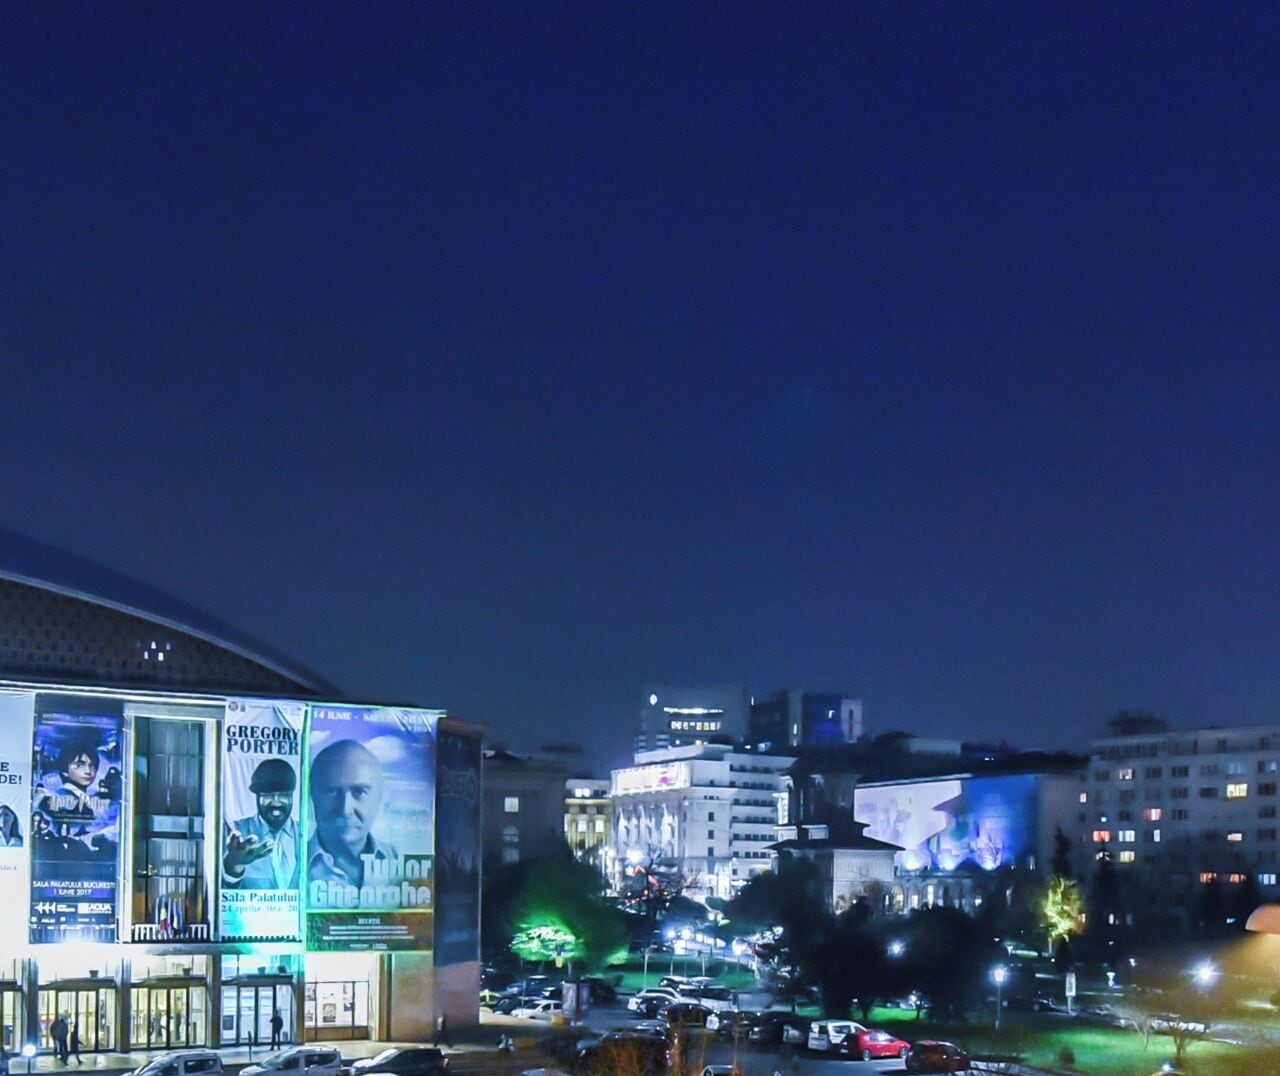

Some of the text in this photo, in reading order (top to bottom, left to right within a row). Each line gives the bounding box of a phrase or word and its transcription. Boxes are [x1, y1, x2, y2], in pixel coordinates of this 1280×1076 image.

[226, 725, 299, 741] GREGORY
[226, 738, 299, 756] PORTER
[360, 854, 433, 880] Tudor
[221, 892, 297, 903] Sala Palatului
[309, 879, 432, 909] Gheorghe
